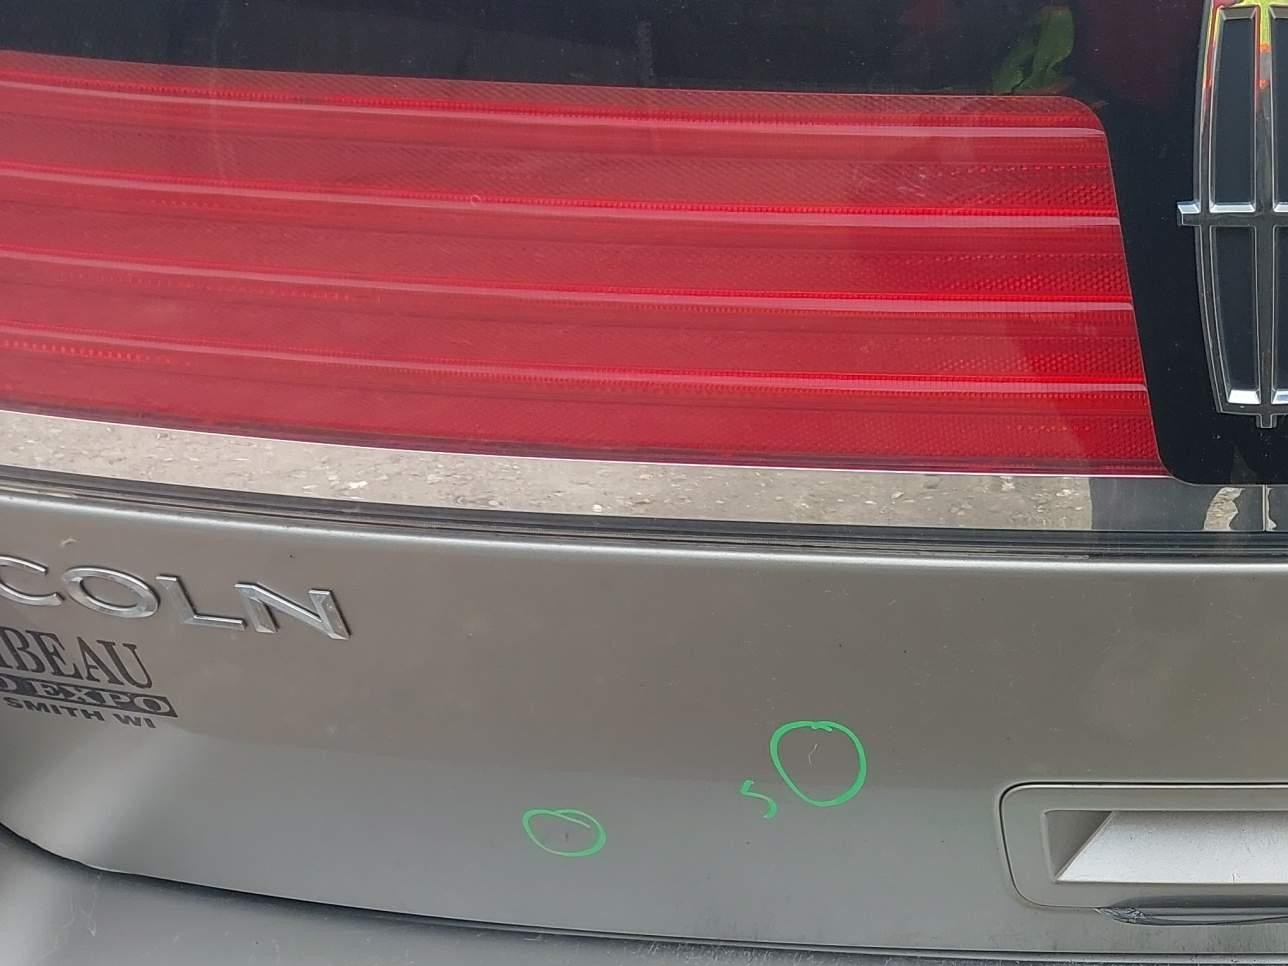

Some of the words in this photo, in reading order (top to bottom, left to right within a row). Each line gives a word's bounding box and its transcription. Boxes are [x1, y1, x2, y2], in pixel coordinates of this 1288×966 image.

[0, 626, 152, 689] BEAU
[3, 697, 105, 721] SMITH
[112, 713, 156, 729] WI
[28, 679, 170, 713] EXPO
